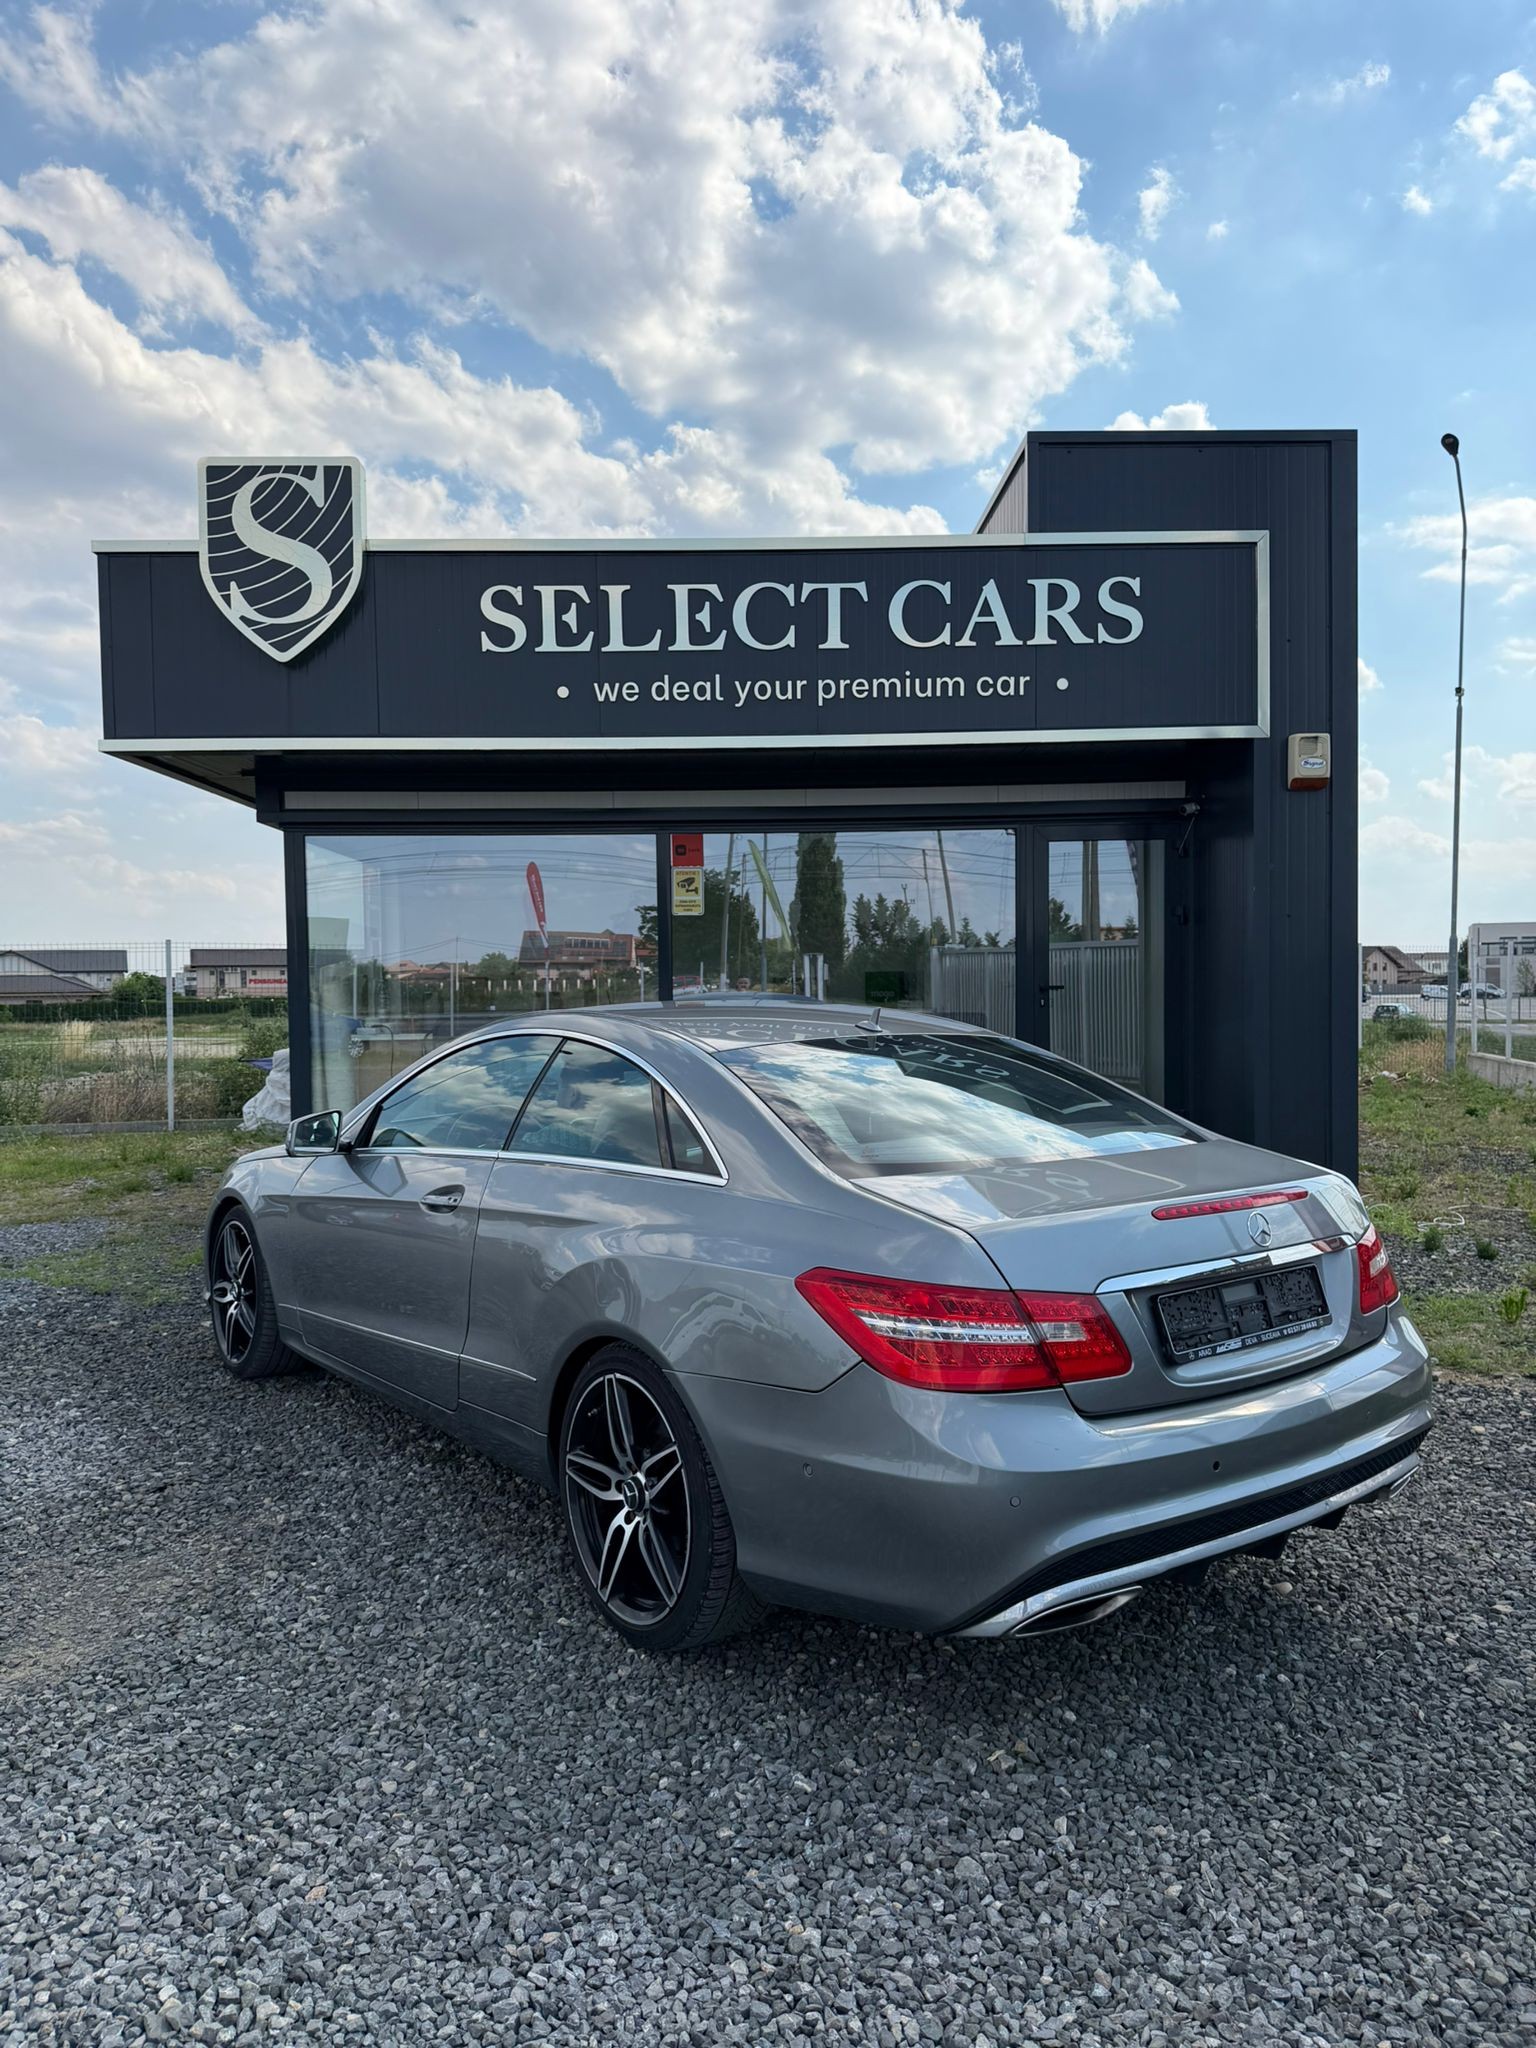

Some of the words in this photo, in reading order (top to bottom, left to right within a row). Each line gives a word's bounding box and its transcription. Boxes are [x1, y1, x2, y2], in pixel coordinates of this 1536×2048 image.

[480, 581, 869, 653] SELECT
[888, 576, 1144, 648] CARS
[593, 682, 641, 702] we
[650, 674, 724, 702] deal
[734, 680, 808, 708] your
[817, 676, 965, 708] premium
[976, 675, 1031, 698] car
